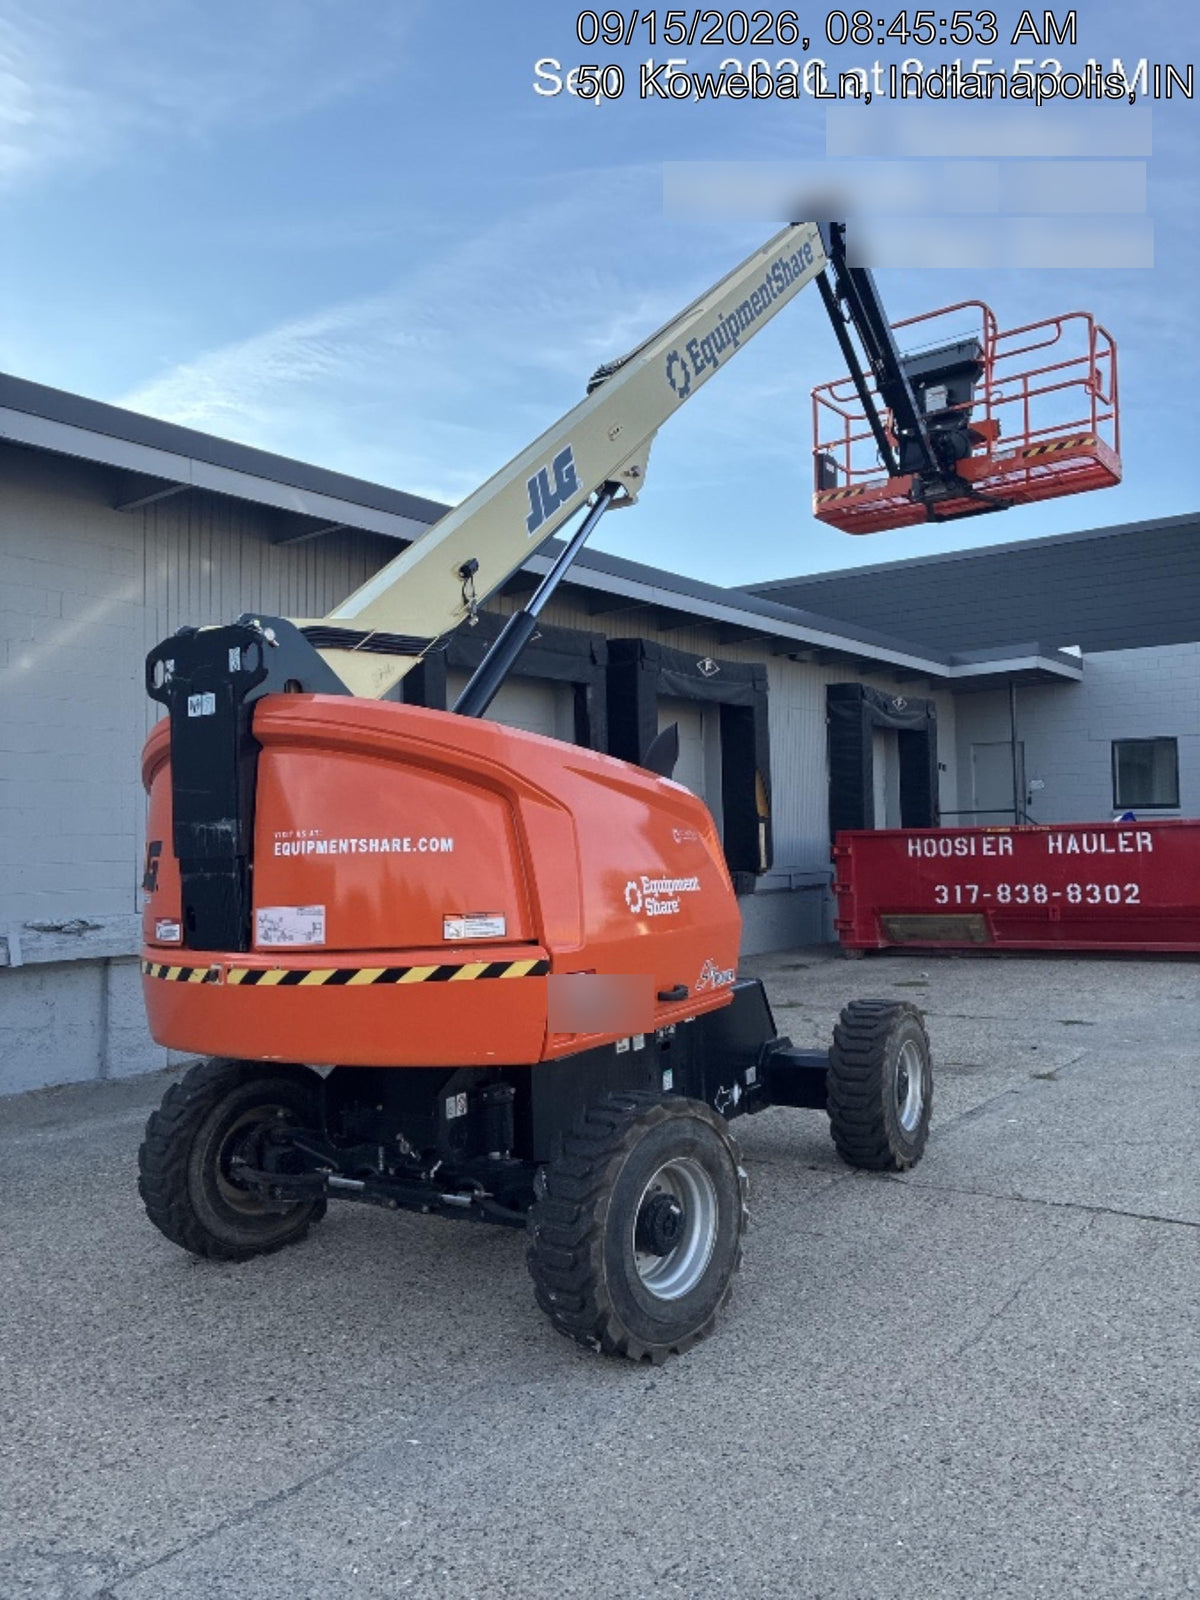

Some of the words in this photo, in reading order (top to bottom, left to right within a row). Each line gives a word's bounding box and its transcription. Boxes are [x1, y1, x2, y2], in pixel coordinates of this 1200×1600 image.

[685, 241, 814, 377] EquipmentShare
[526, 443, 580, 537] JLG
[273, 837, 453, 857] EQUIPMENTSHARE.COM
[907, 836, 1014, 858] HOOSIER
[1048, 831, 1154, 855] HAULER
[640, 874, 701, 897] Equipment
[934, 883, 1141, 905] 317-838-8302
[645, 896, 681, 917] Share
